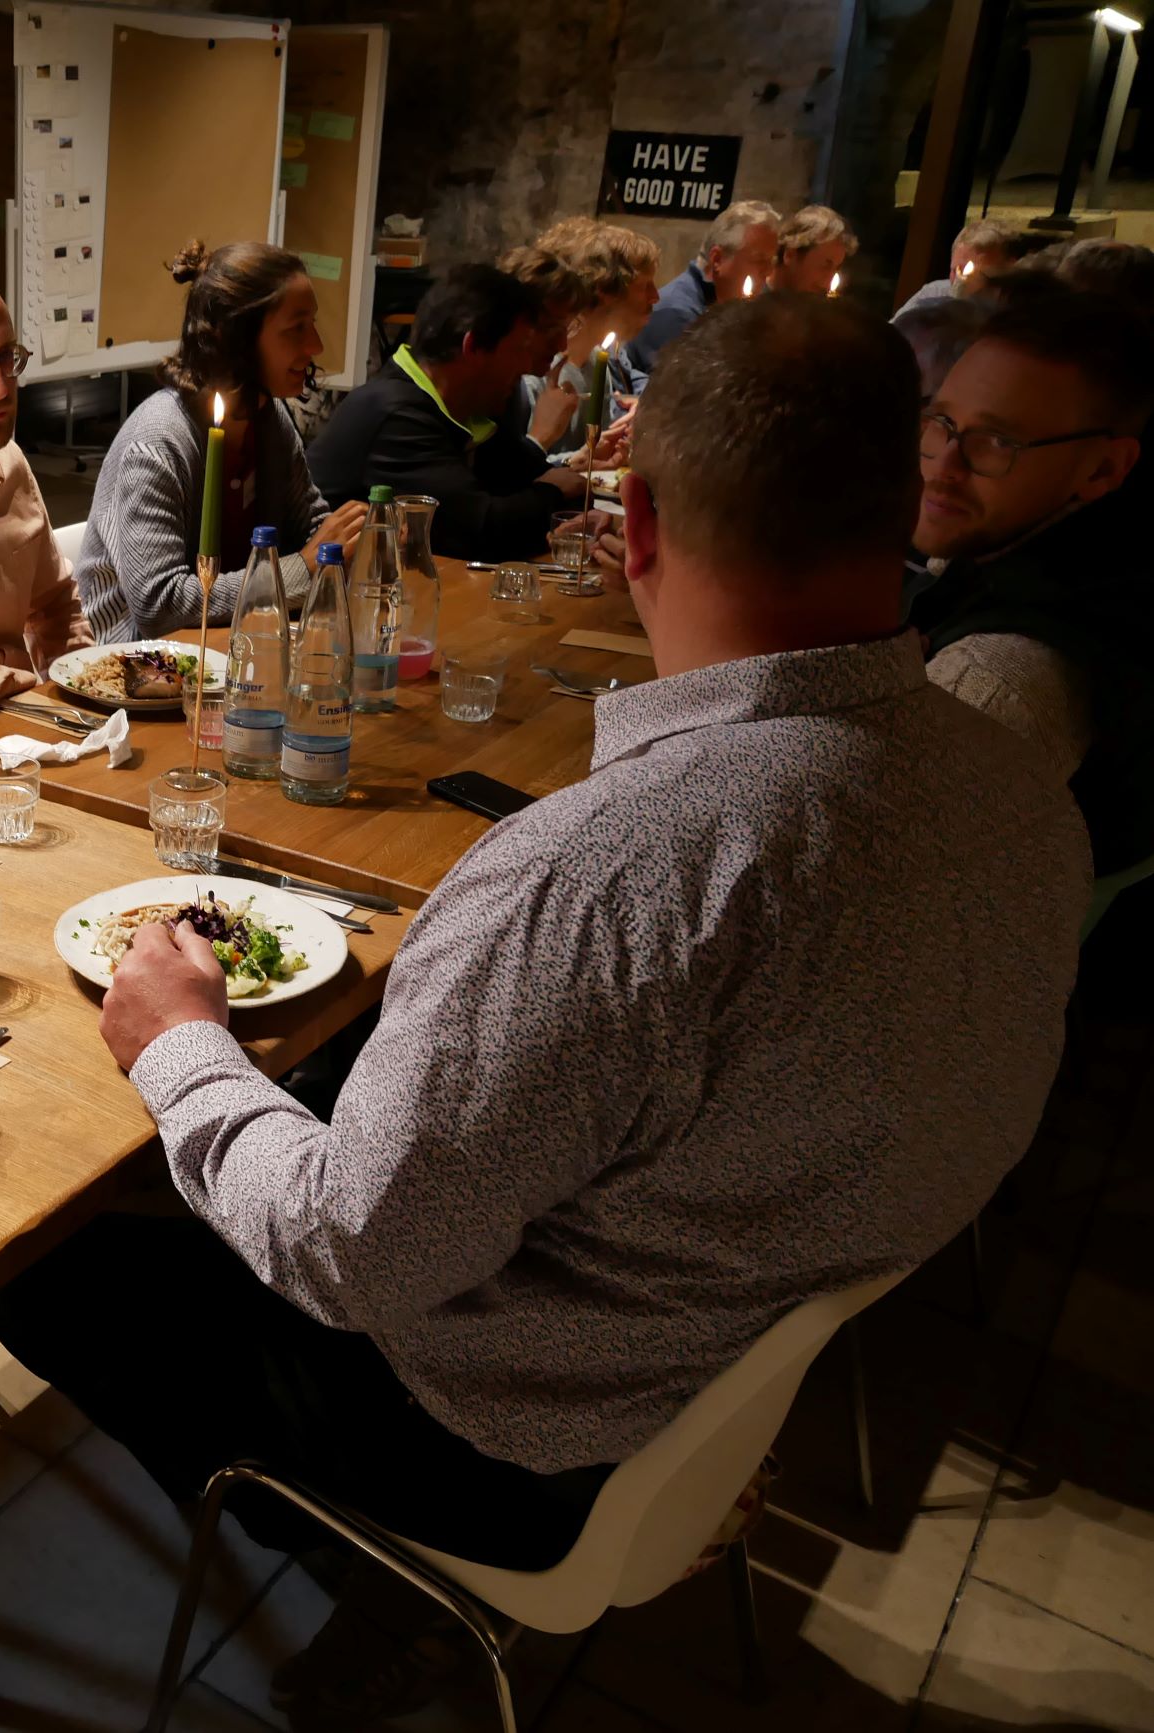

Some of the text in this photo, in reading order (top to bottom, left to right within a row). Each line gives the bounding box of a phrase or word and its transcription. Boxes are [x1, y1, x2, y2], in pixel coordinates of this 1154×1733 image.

[632, 142, 710, 173] HAVE
[623, 176, 675, 207] GOOD
[680, 180, 724, 211] TIME
